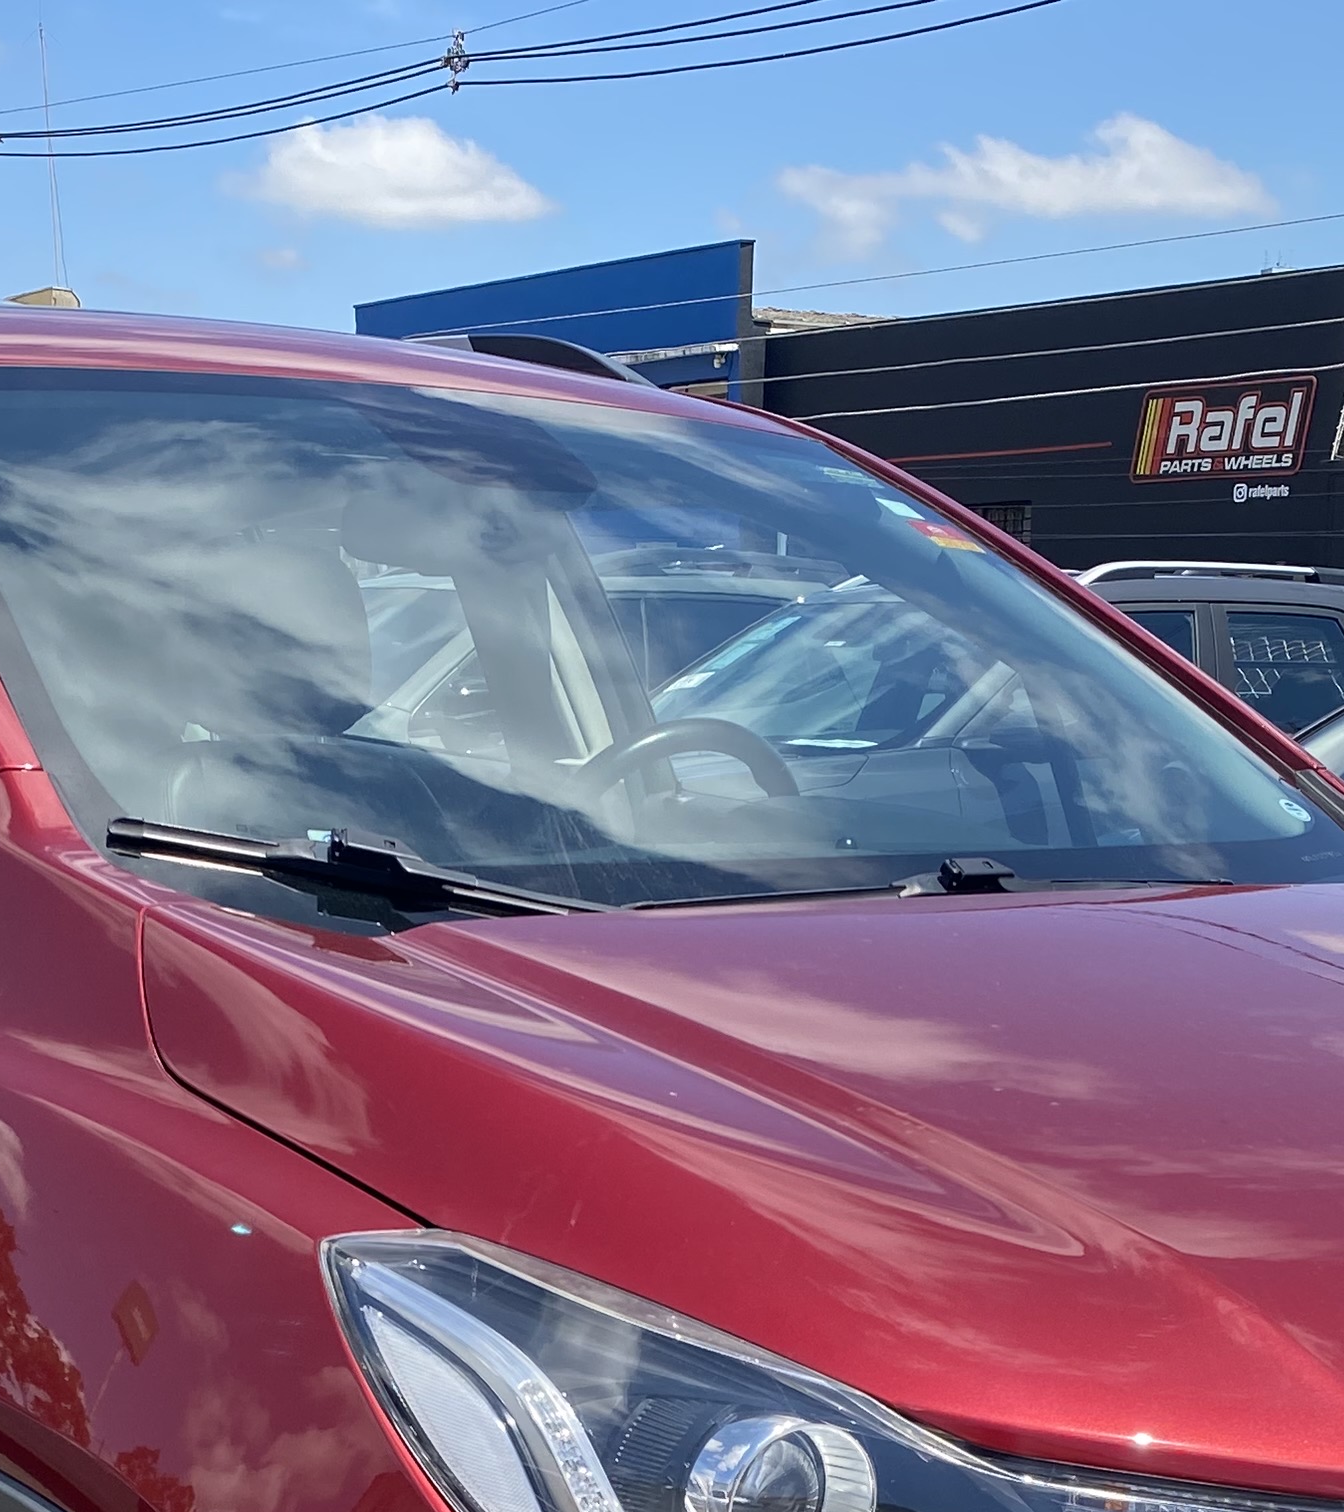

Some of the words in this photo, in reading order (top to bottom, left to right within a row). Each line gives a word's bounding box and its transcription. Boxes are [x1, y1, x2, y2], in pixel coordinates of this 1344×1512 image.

[1165, 390, 1305, 455] Rafel
[1159, 458, 1213, 475] PARTS
[1224, 453, 1293, 471] WHEELS
[1248, 484, 1290, 500] rafelparts
